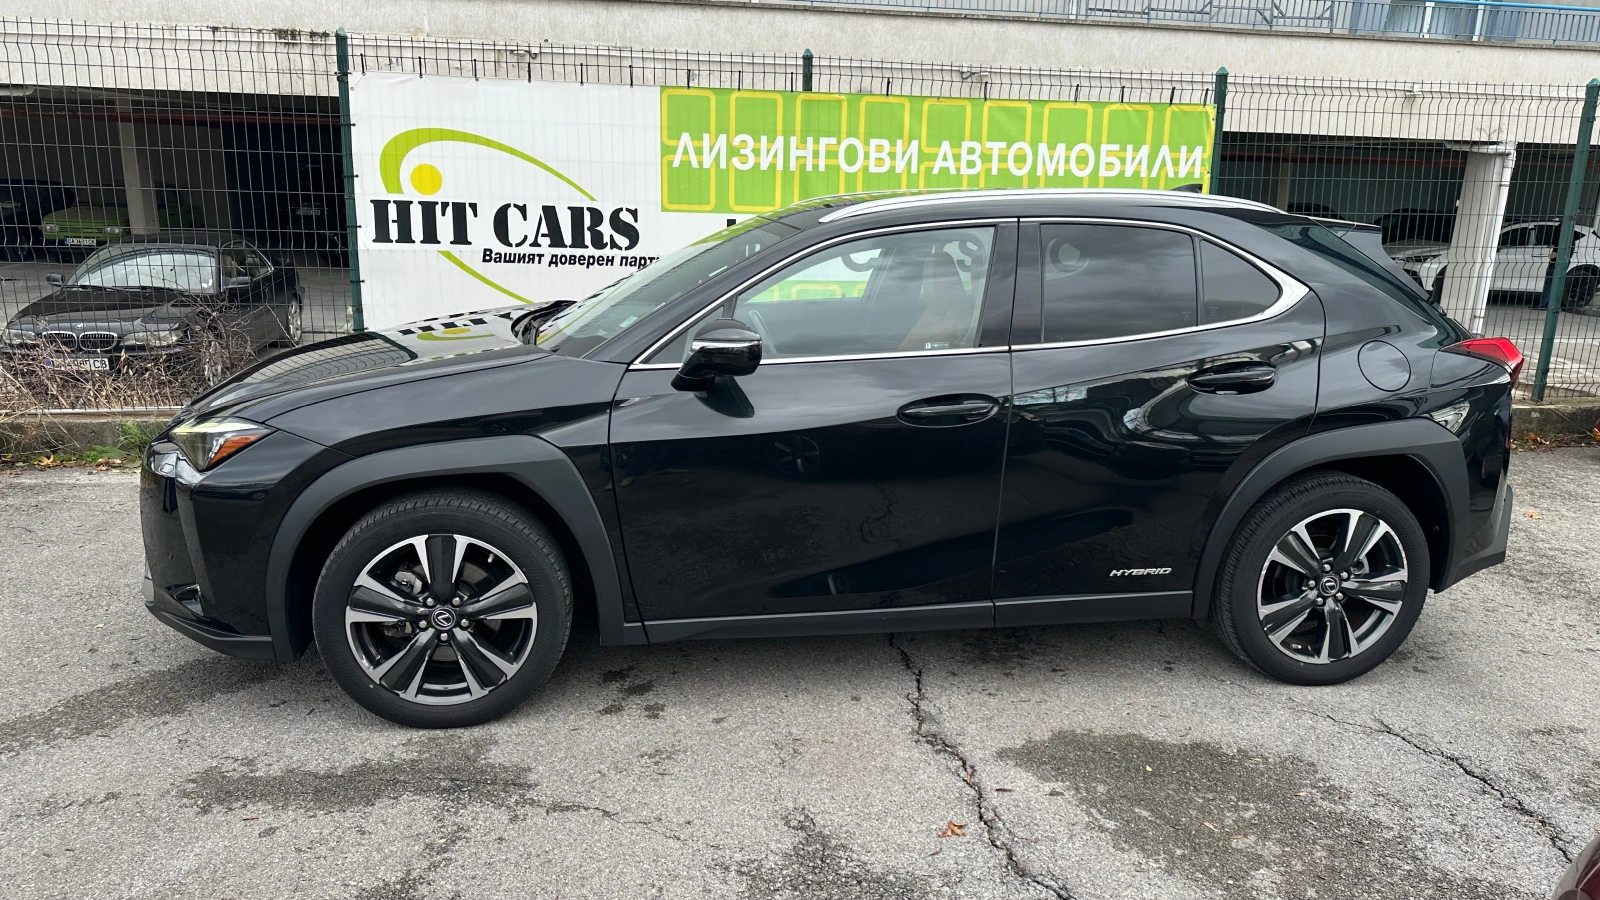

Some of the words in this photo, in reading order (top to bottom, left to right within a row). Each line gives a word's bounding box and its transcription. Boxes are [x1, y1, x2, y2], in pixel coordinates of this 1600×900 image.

[672, 132, 919, 174] ЛИЗИНГОВИ
[932, 140, 1203, 179] АВТОМОБИЛИ
[370, 199, 478, 246] HIT
[493, 203, 640, 251] CARS
[482, 248, 545, 265] Вашият
[548, 253, 615, 269] доверен
[619, 255, 660, 270] парт
[1109, 567, 1172, 577] HYBRID
